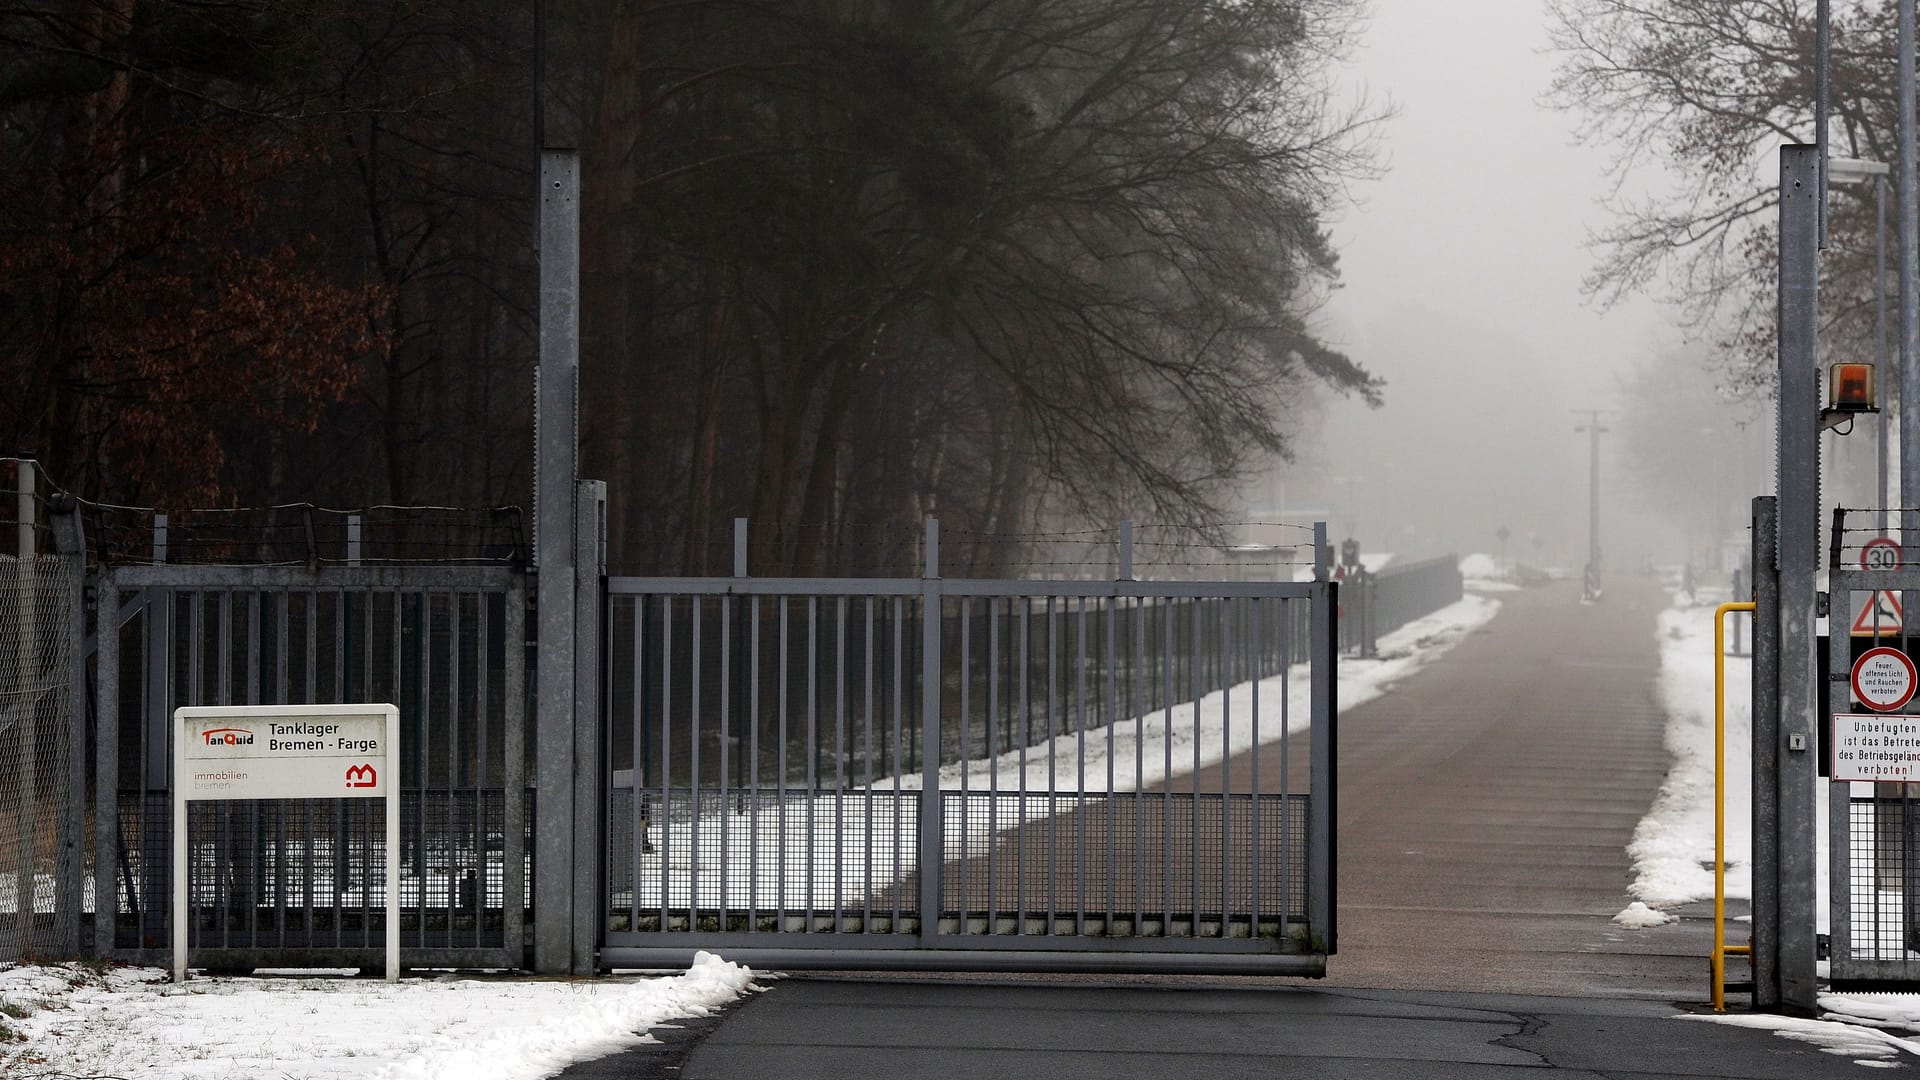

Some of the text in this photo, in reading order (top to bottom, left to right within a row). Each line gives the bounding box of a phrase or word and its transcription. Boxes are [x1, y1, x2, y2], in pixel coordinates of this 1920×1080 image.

[1870, 549, 1895, 569] 30
[1876, 661, 1892, 669] Feuer
[269, 722, 339, 739] Tanklager
[1854, 721, 1917, 735] Unbefugten
[202, 728, 254, 746] TanQuid
[1844, 736, 1857, 746] ist
[1862, 736, 1879, 746] das
[269, 739, 324, 751] Bremen
[338, 738, 377, 752] Farge
[1838, 749, 1854, 760] des
[194, 770, 248, 780] immobilien
[1857, 763, 1913, 775] verboten!
[194, 781, 231, 791] bremen
